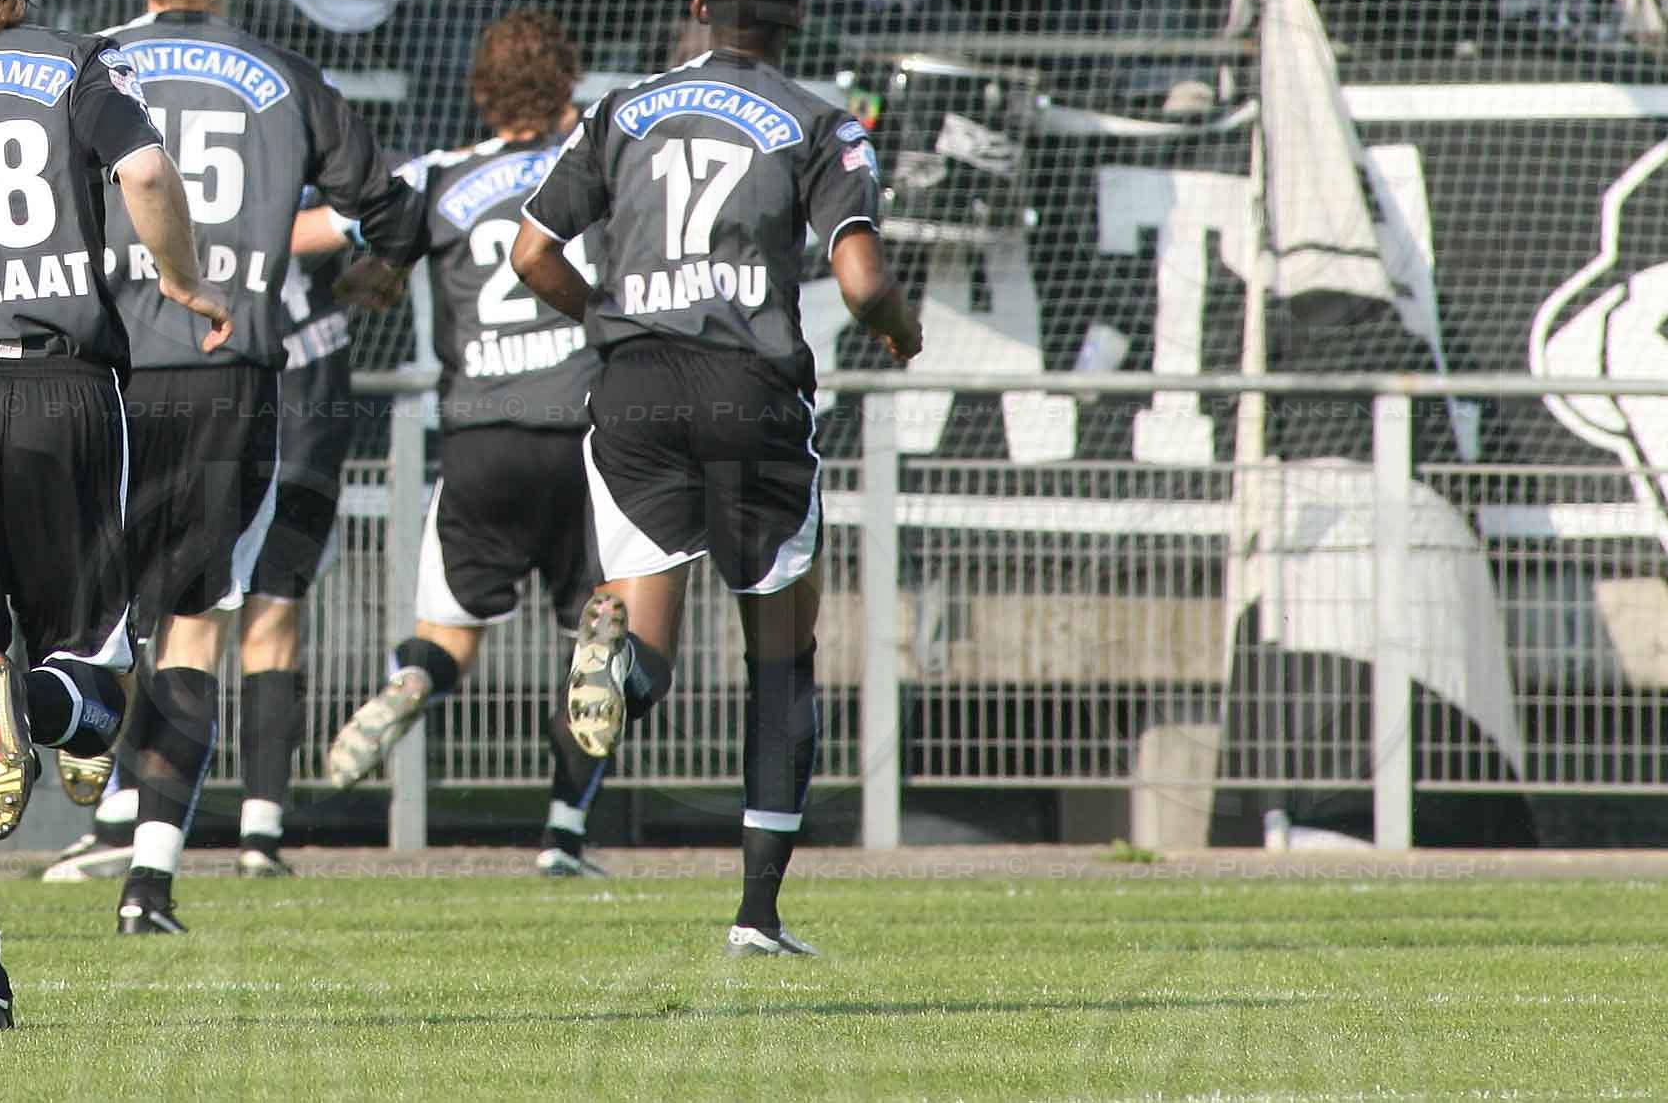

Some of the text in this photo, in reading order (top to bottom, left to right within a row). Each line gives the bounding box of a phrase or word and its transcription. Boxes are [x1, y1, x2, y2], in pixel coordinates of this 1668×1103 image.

[127, 46, 279, 106] NTIGAMER
[621, 87, 792, 147] PUNTIGAMER
[652, 139, 753, 260] 17
